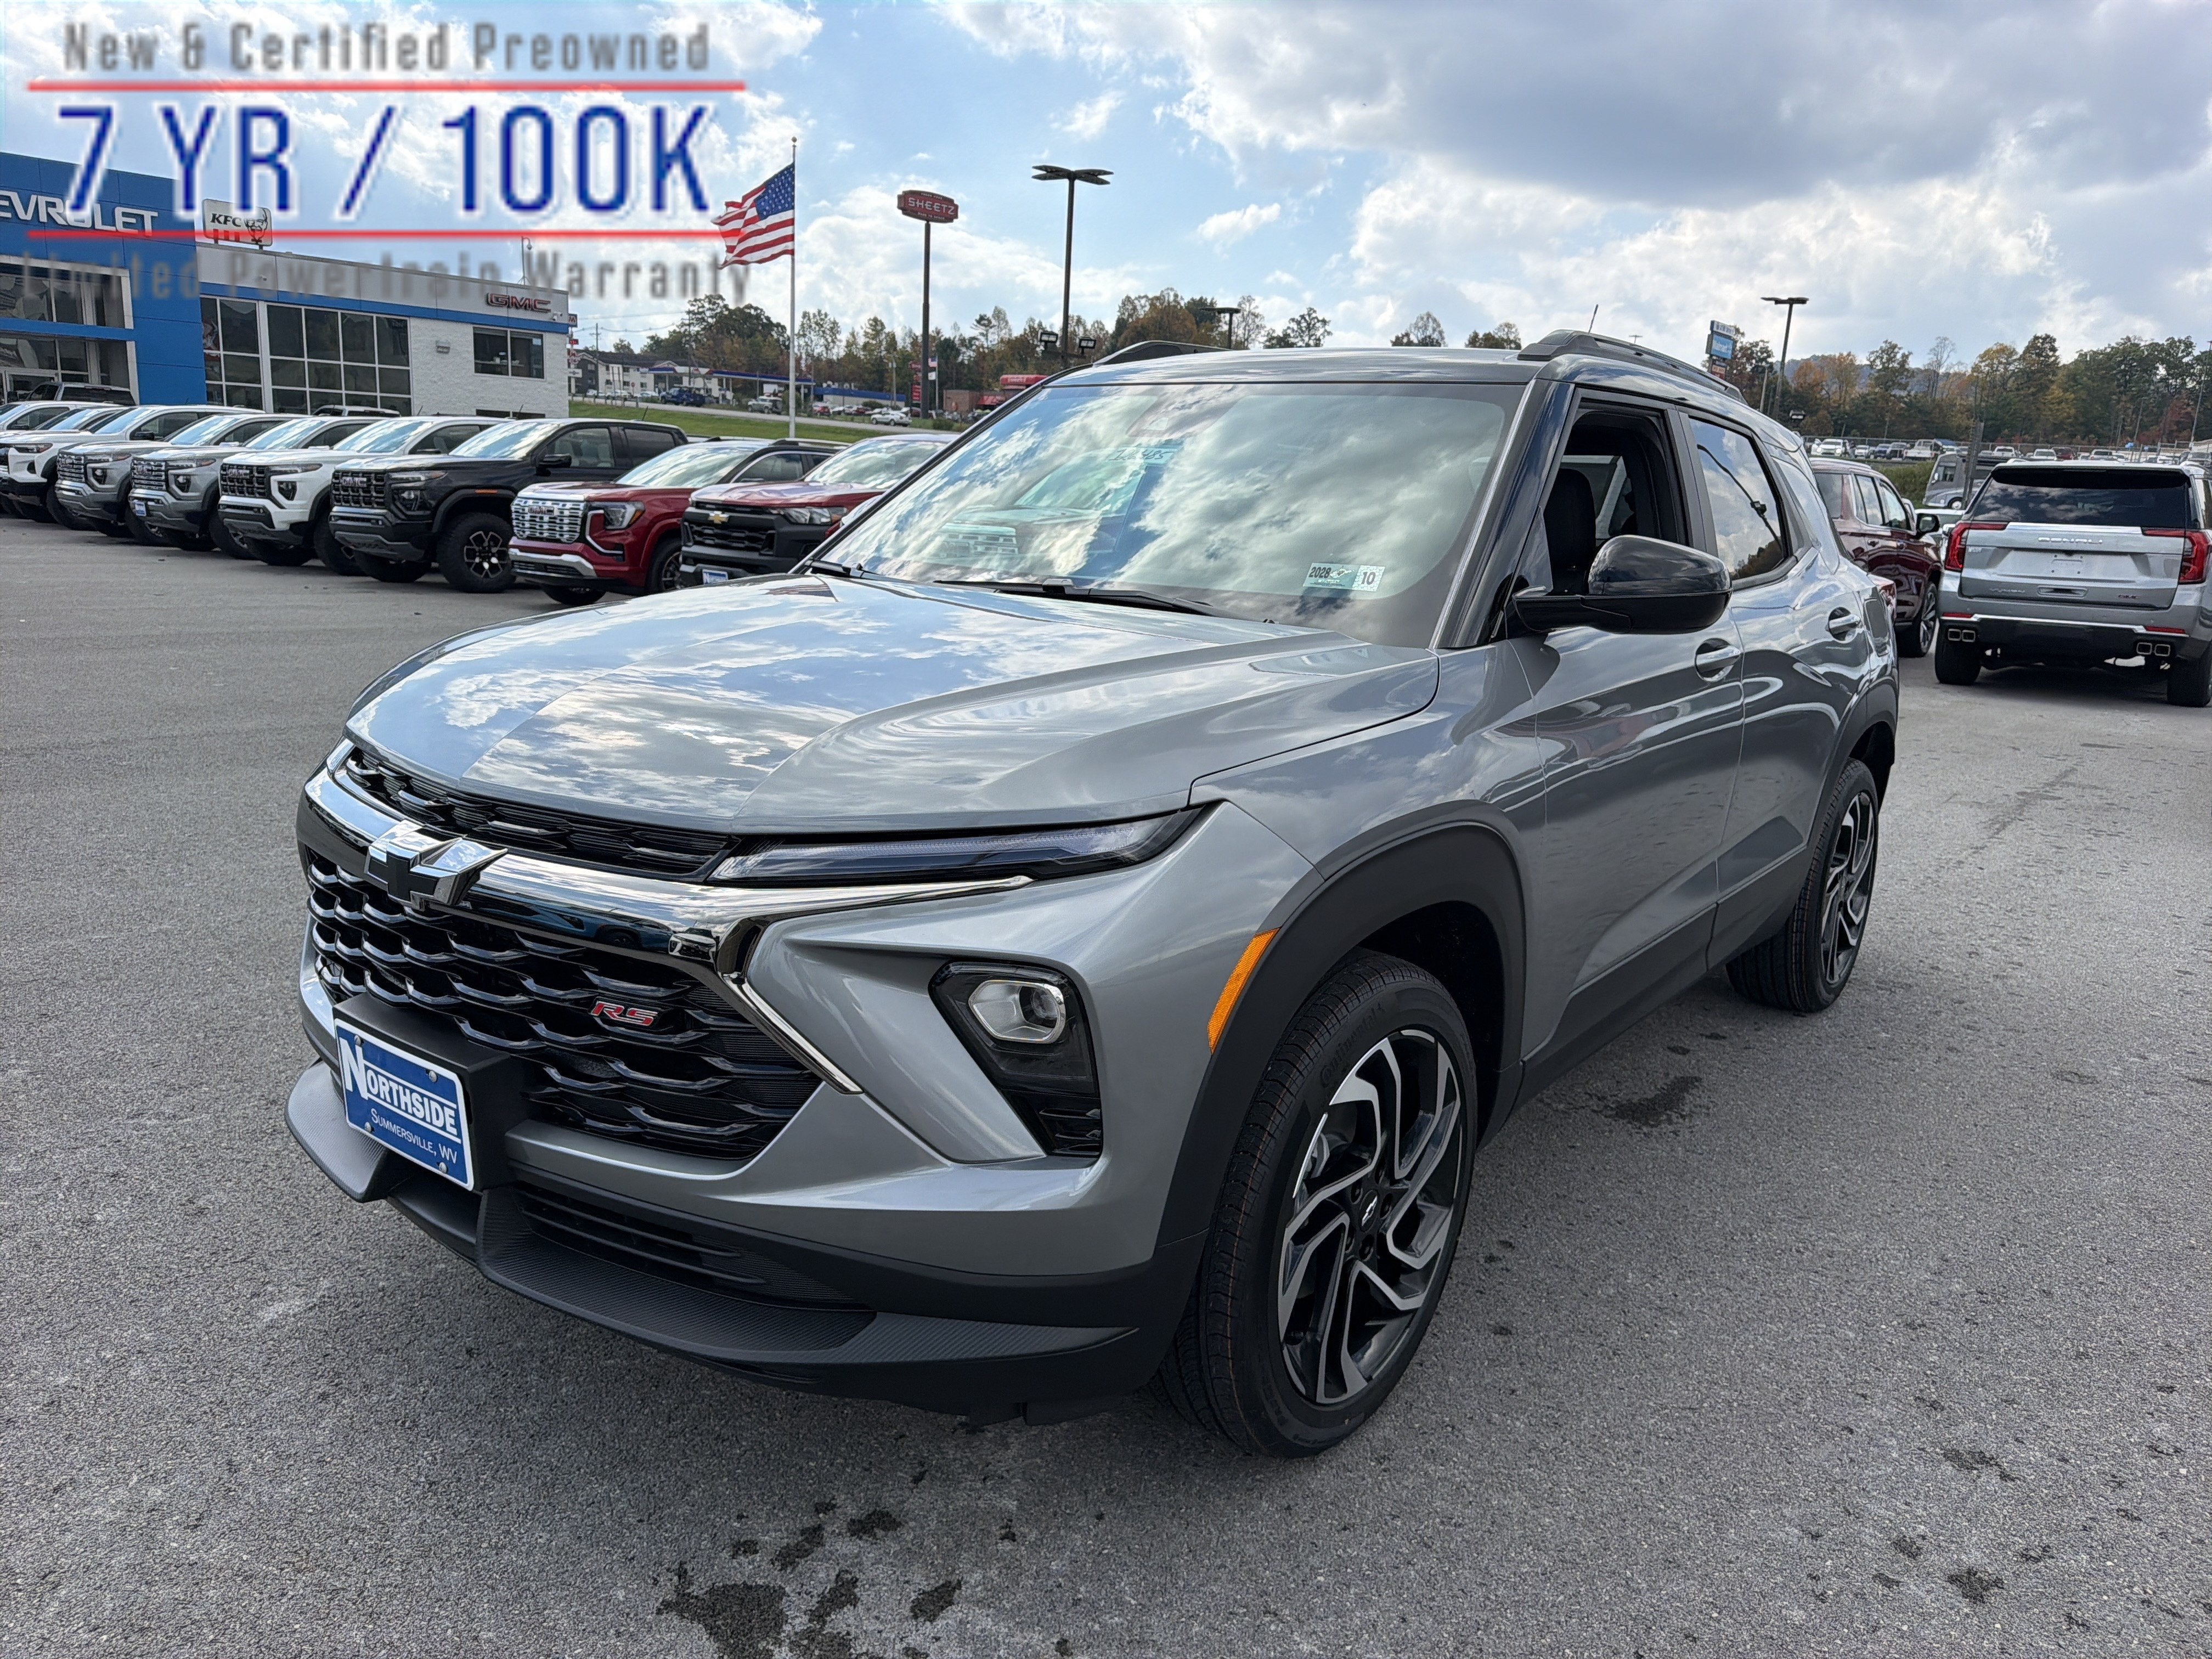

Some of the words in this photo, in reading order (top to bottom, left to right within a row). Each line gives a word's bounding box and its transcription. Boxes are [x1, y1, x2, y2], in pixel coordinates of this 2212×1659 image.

[908, 197, 955, 215] SHEETZ
[210, 213, 241, 228] KFC
[486, 292, 551, 313] GMC
[1308, 566, 1332, 579] 2028
[1361, 571, 1376, 585] 10
[591, 1001, 658, 1026] RS
[438, 1143, 458, 1165] WV
